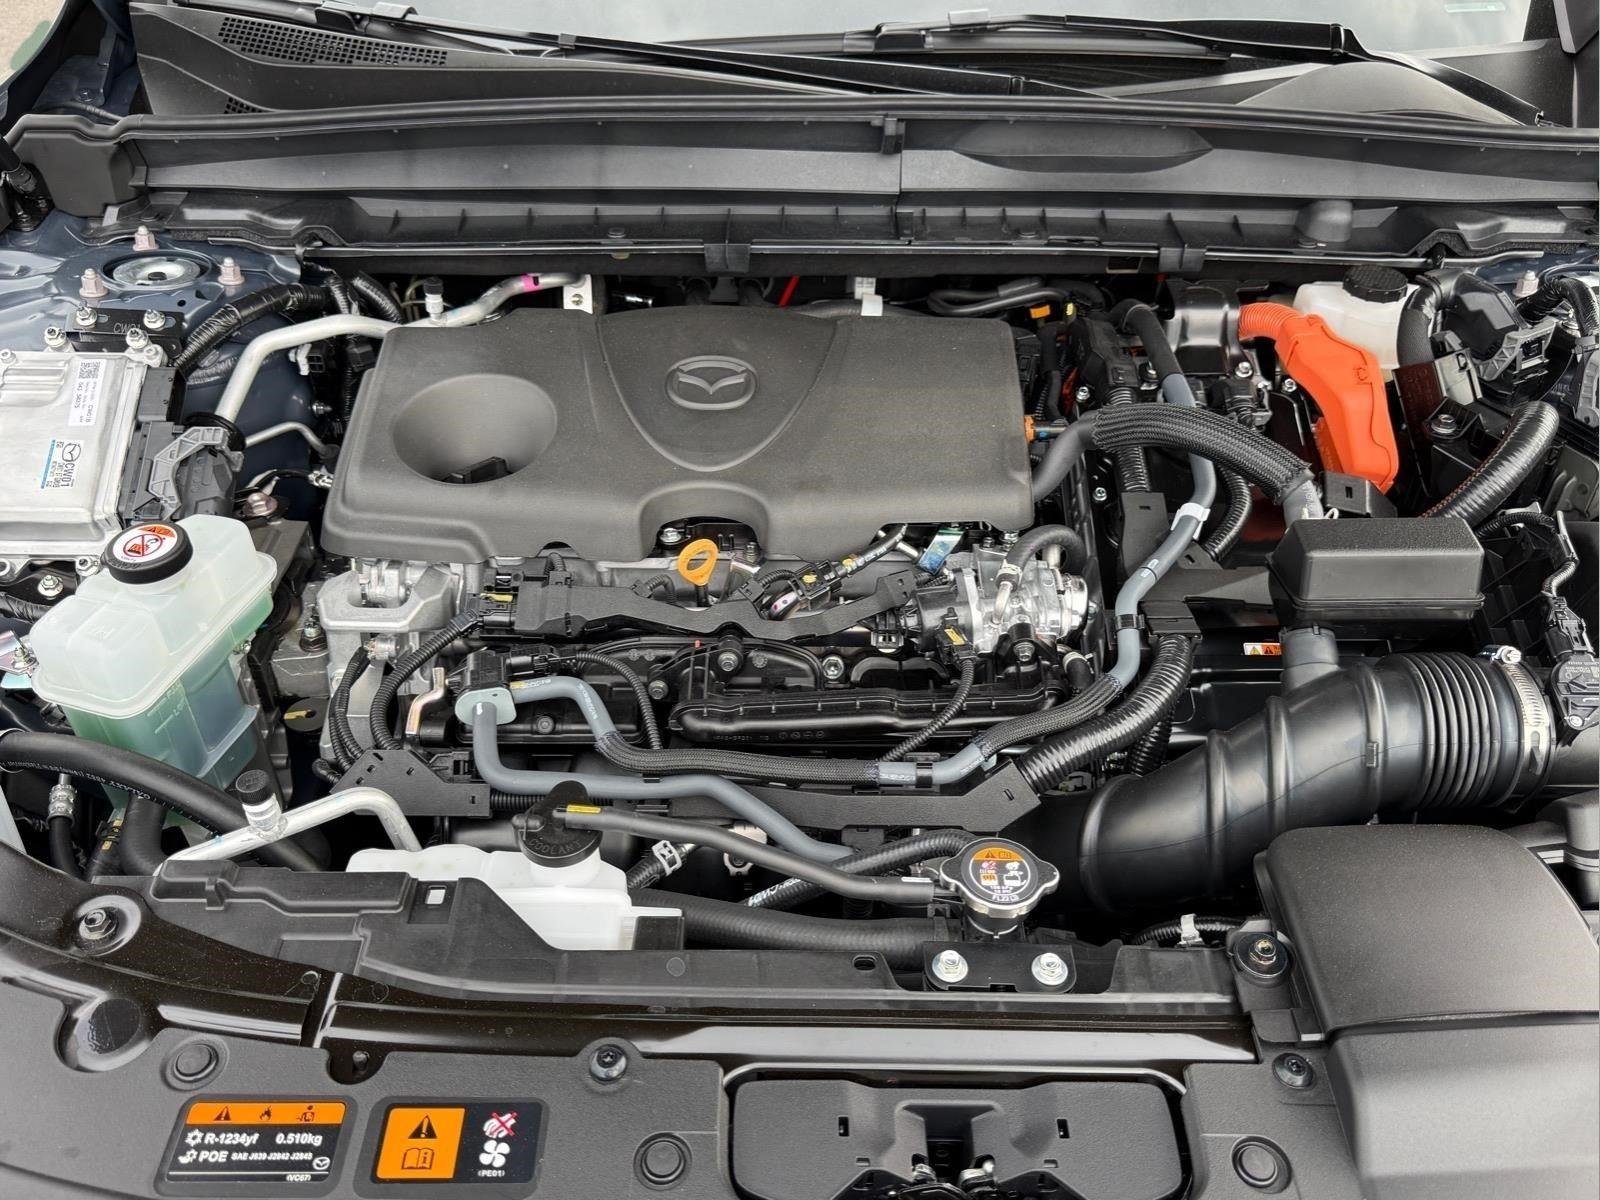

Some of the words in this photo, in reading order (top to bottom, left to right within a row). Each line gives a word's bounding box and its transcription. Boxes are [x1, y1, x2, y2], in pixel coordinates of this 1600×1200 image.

[204, 1133, 259, 1146] R-1234yf
[275, 1133, 322, 1146] 0.510kg
[198, 1150, 229, 1162] POE
[231, 1152, 249, 1160] SAE
